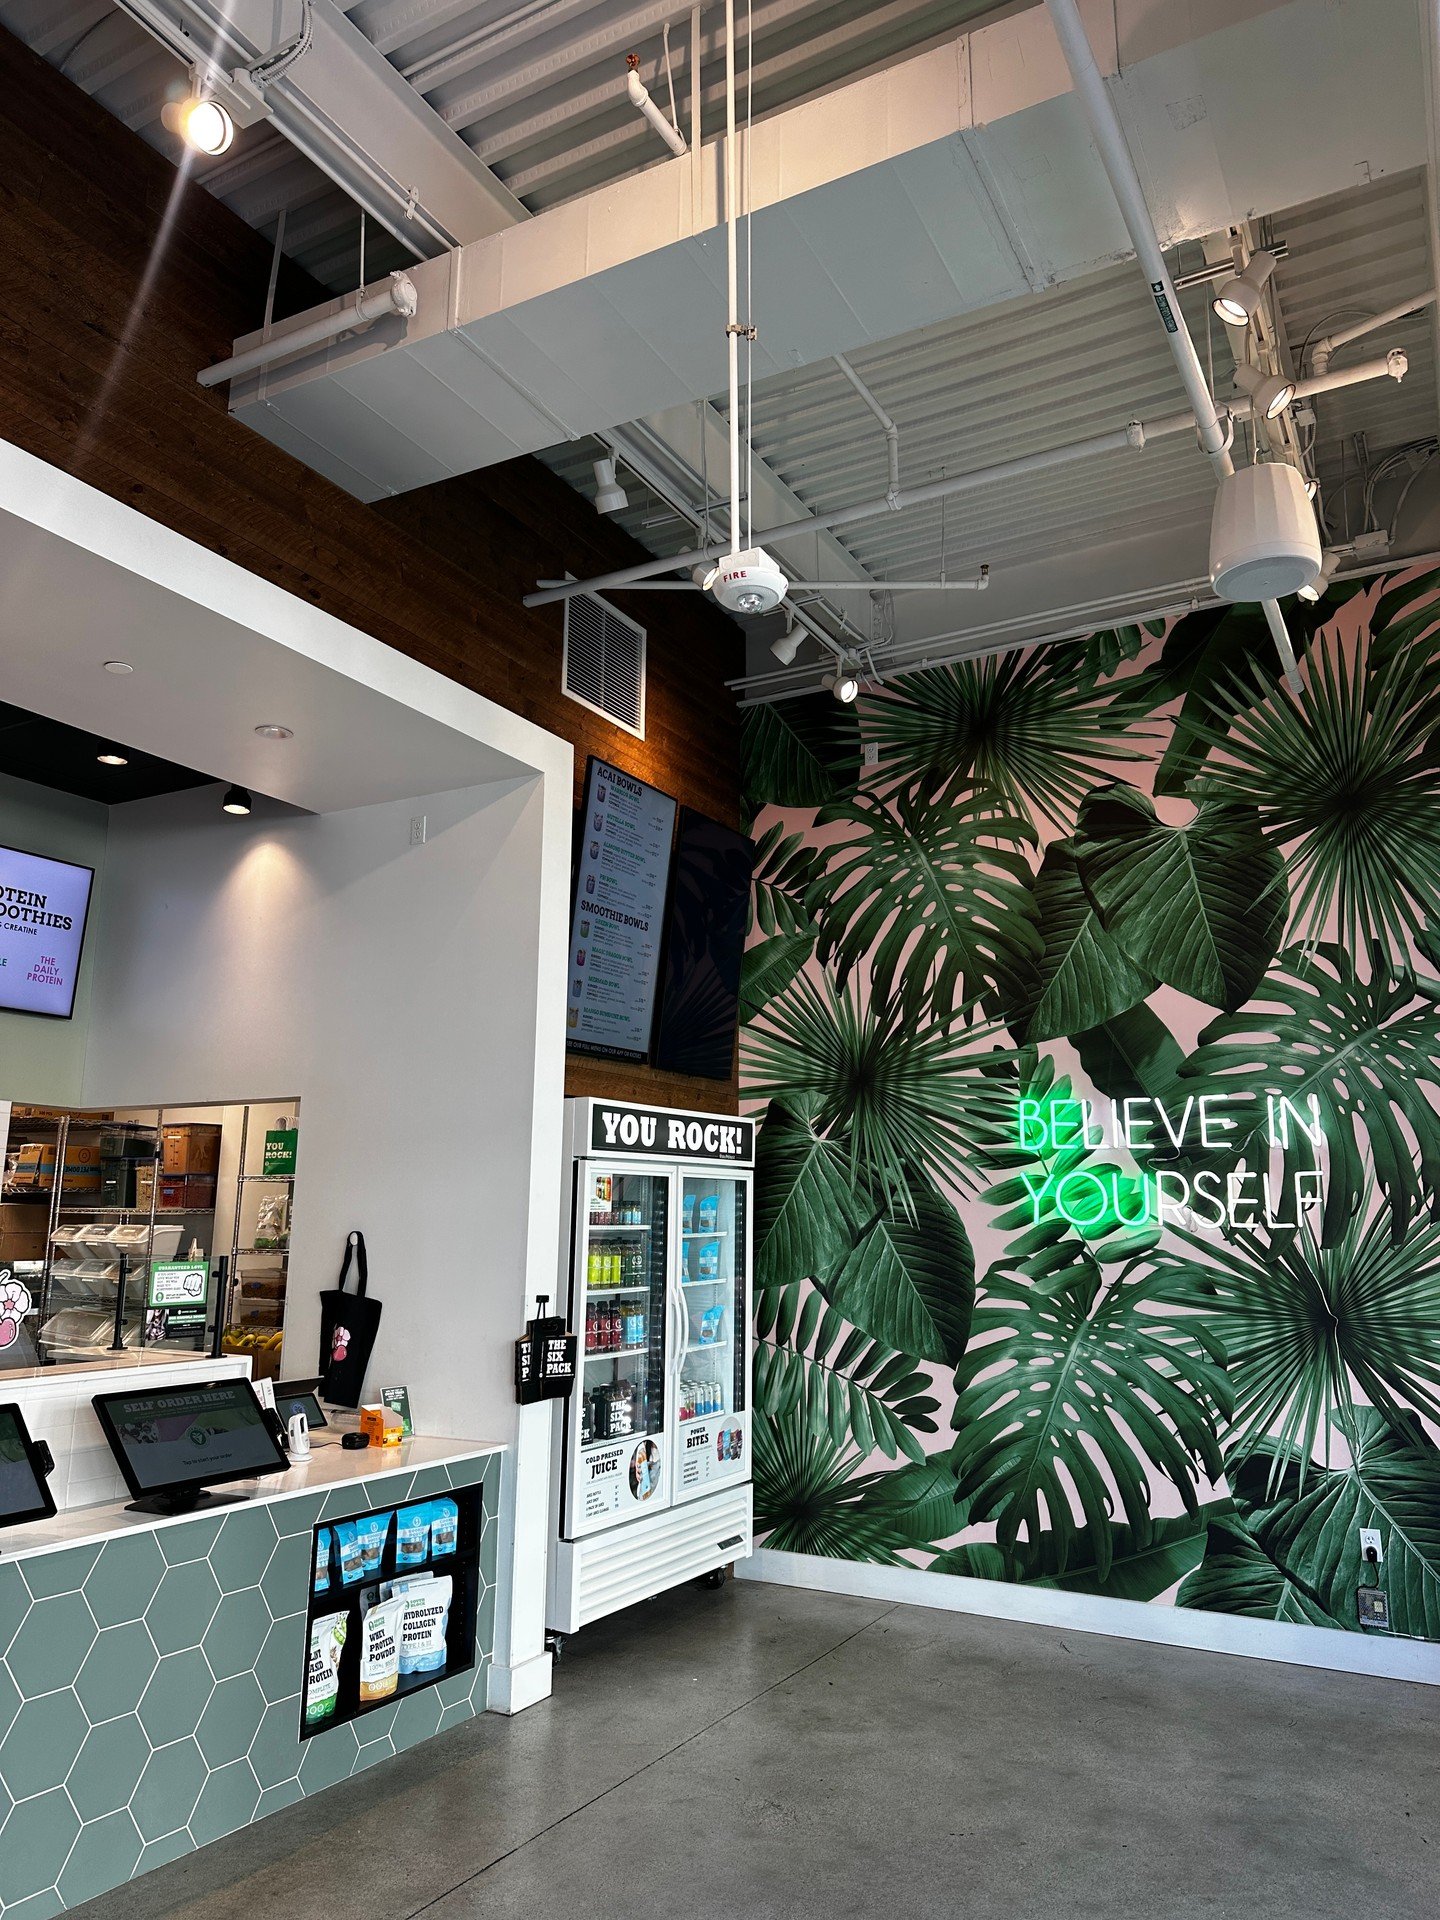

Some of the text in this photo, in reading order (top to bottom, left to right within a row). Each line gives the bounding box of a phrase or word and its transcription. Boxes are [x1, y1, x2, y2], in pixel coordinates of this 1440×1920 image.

[723, 570, 747, 583] FIRE
[597, 766, 643, 797] ACAI BOWLS
[581, 900, 623, 923] SMOOTHIE
[624, 914, 649, 931] BOWLS
[4, 922, 38, 936] CREATINE
[40, 956, 56, 966] THE
[34, 964, 60, 976] DAILY
[27, 972, 64, 986] PROTEIN
[1018, 1093, 1322, 1151] BELIEVE IN
[602, 1111, 742, 1155] YOU ROCK!
[266, 1142, 284, 1150] YOU
[1020, 1170, 1324, 1229] YOURSELF
[548, 1340, 566, 1350] THE
[547, 1352, 564, 1362] SIX
[546, 1362, 572, 1374] PACK
[123, 1401, 154, 1413] SELF
[157, 1396, 202, 1408] ORDER
[202, 1390, 235, 1402] HERE
[610, 1400, 627, 1412] THE
[610, 1410, 625, 1422] SIX
[610, 1421, 632, 1433] PACK
[687, 1433, 709, 1448] BITES
[586, 1449, 623, 1464] COLD PRESSED
[591, 1459, 618, 1479] JUICE
[404, 1606, 444, 1620] HYDROLYZED
[403, 1618, 436, 1631] COLLAGEN
[369, 1628, 385, 1642] WHEY
[403, 1630, 432, 1641] PROTEIN
[370, 1636, 394, 1652] PROTEIN
[369, 1646, 396, 1662] POWDER
[309, 1668, 334, 1684] ROTEIN
